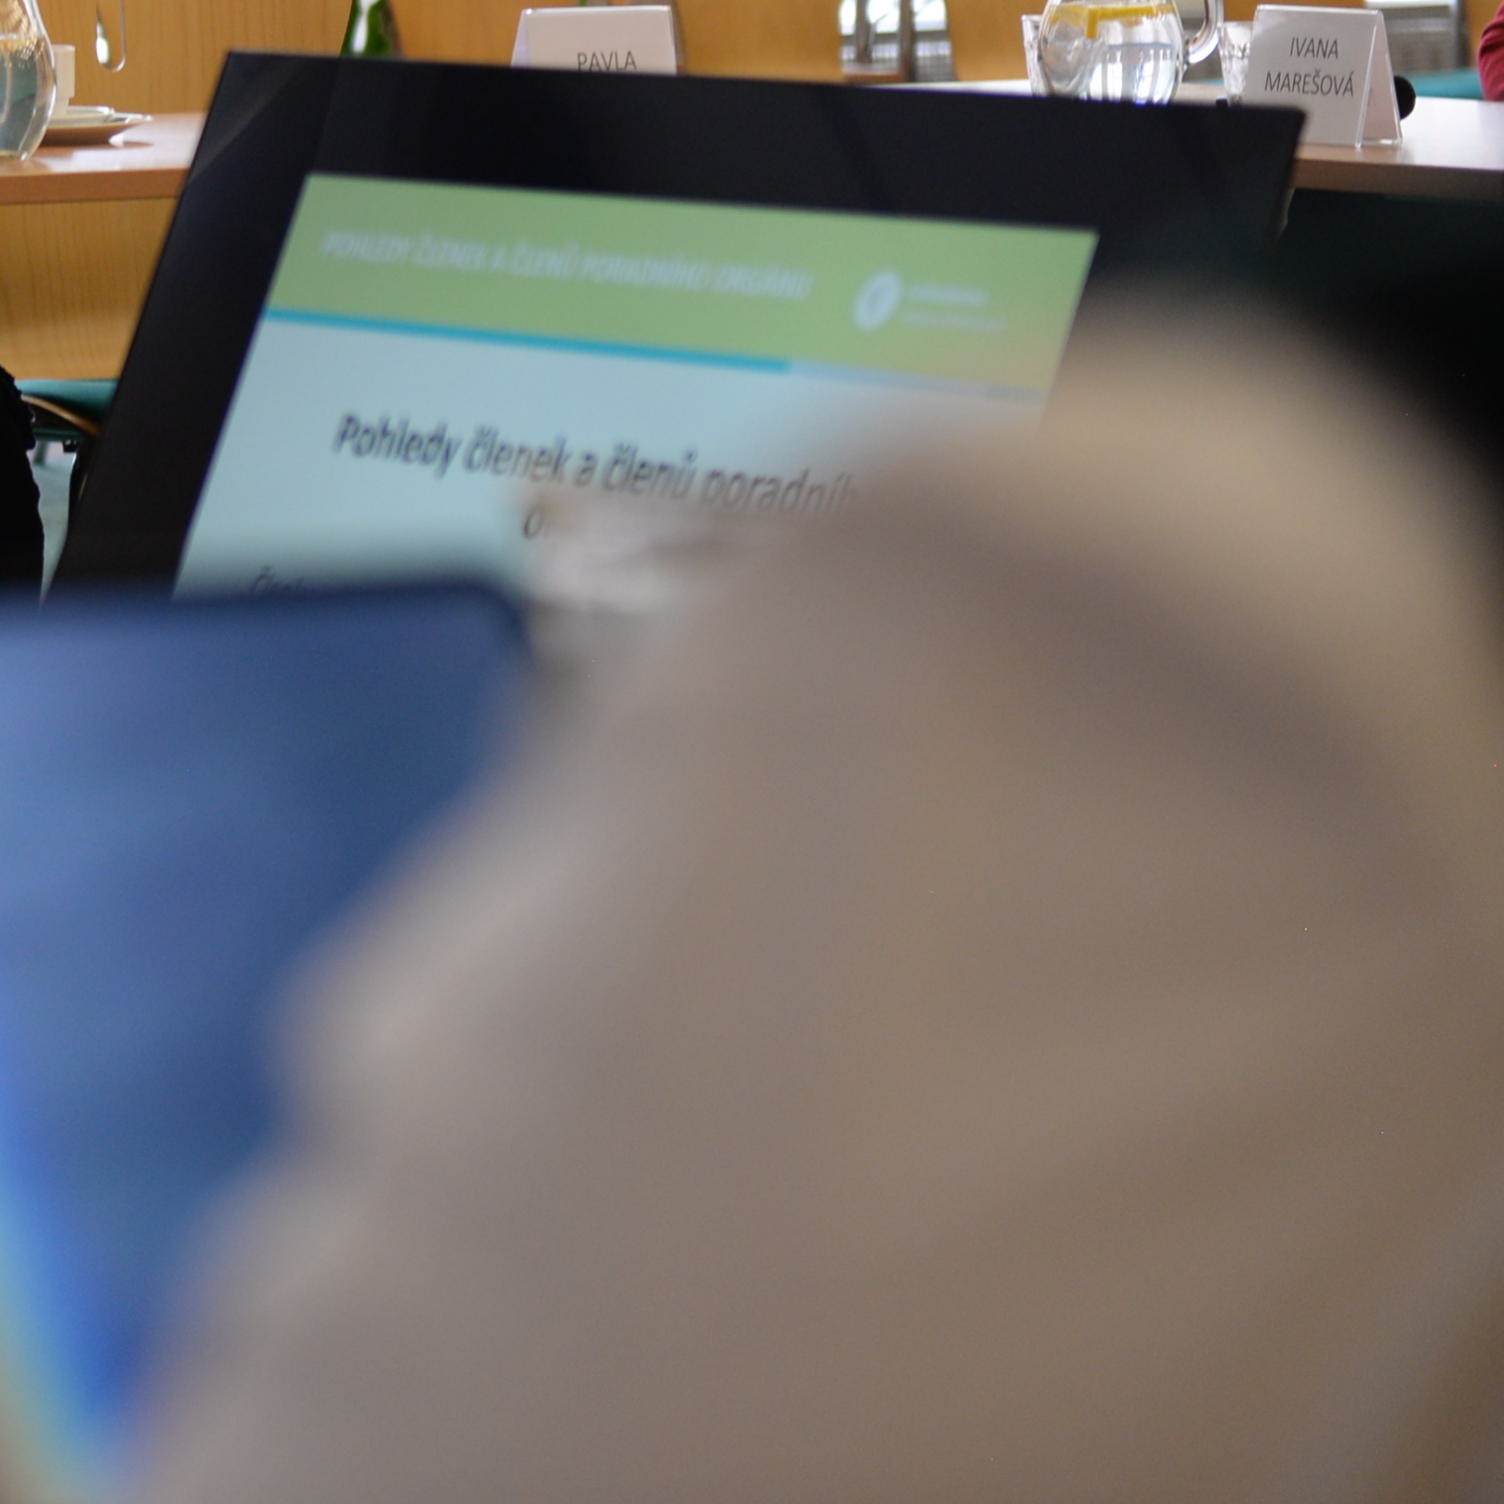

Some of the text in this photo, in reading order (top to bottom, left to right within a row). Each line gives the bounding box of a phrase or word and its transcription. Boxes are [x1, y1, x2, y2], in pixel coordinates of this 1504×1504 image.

[1290, 37, 1339, 59] IVANA
[577, 50, 637, 72] PAVLA
[1264, 70, 1354, 96] MAREŠOVÁ
[333, 413, 461, 479] Pohledy
[462, 424, 570, 483] členek
[572, 452, 598, 486] a
